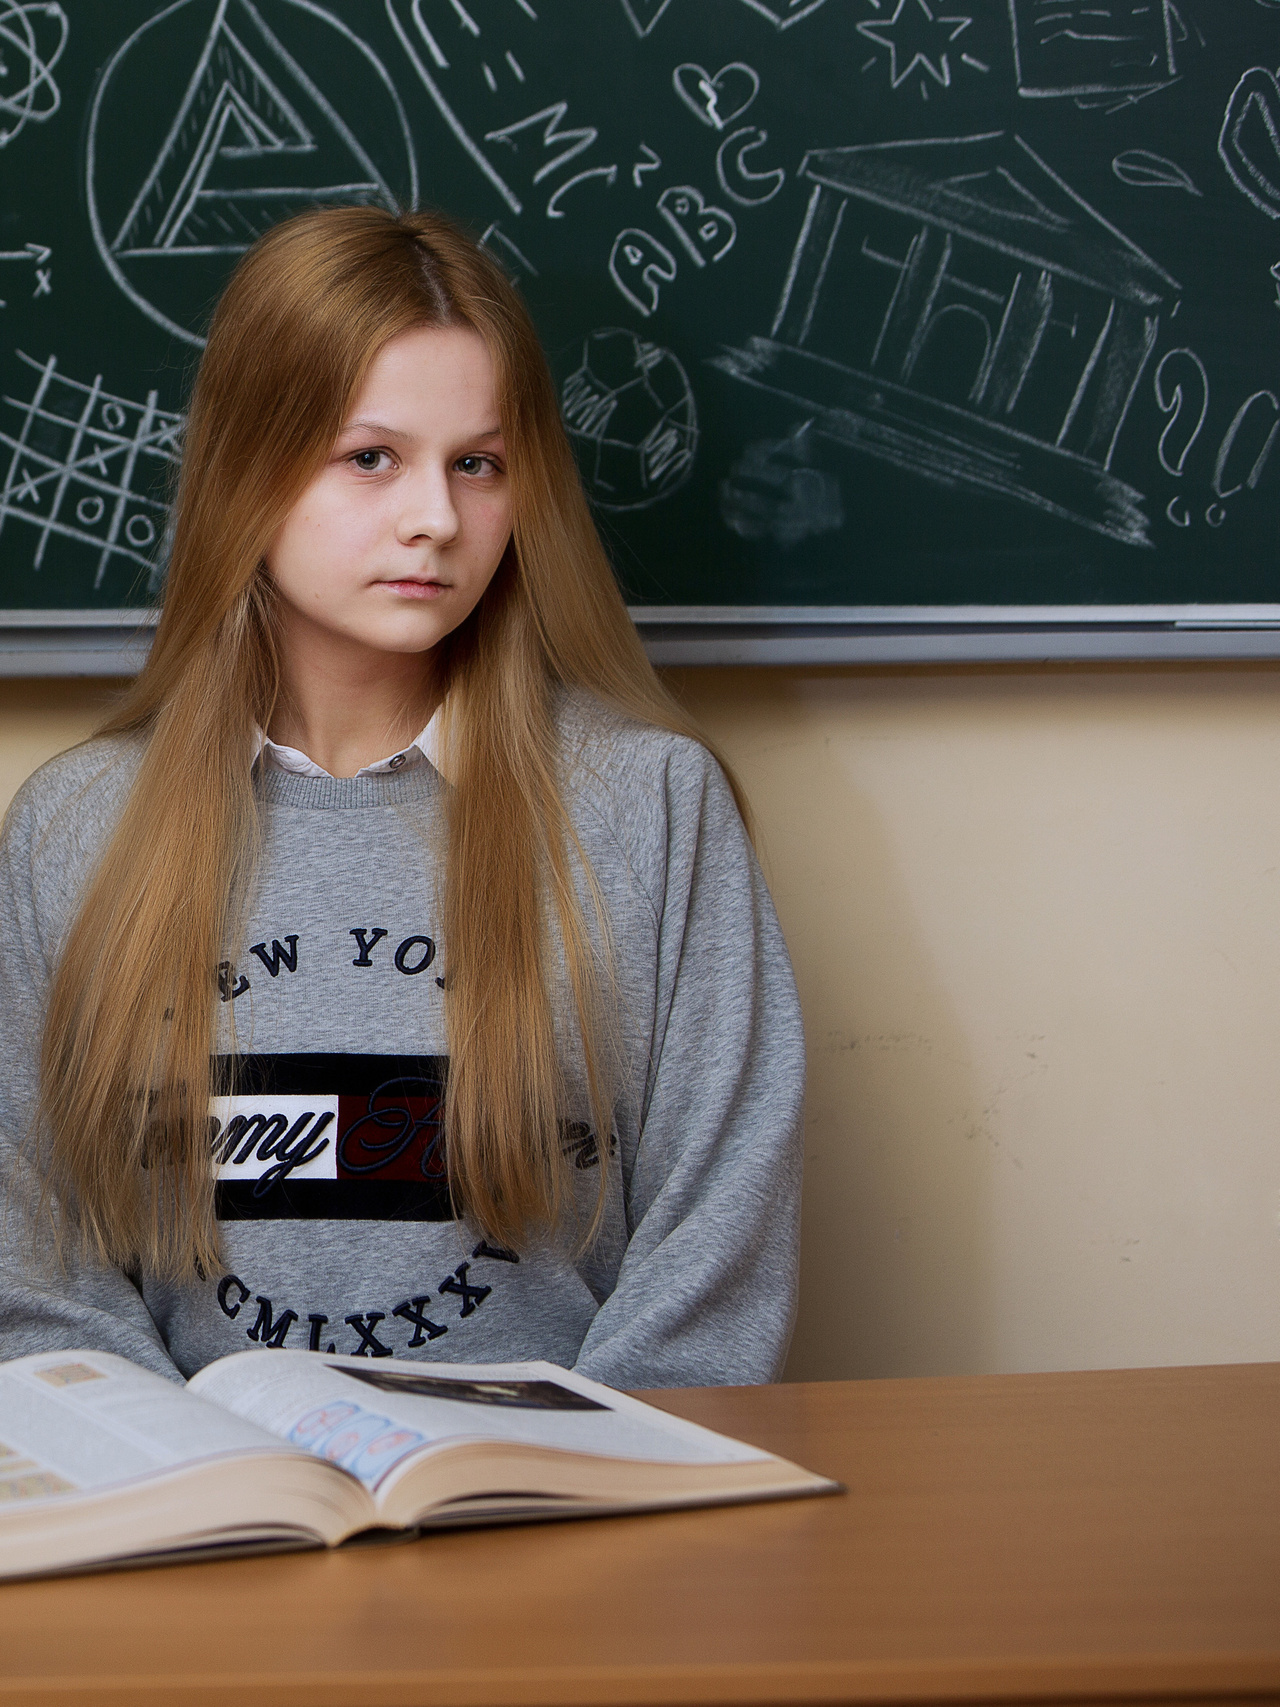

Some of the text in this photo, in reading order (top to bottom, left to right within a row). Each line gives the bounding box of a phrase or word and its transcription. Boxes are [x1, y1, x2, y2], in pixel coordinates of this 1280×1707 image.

[609, 126, 786, 317] ABC
[216, 927, 452, 1002] EW YO
[194, 1240, 520, 1358] CMLXXX
